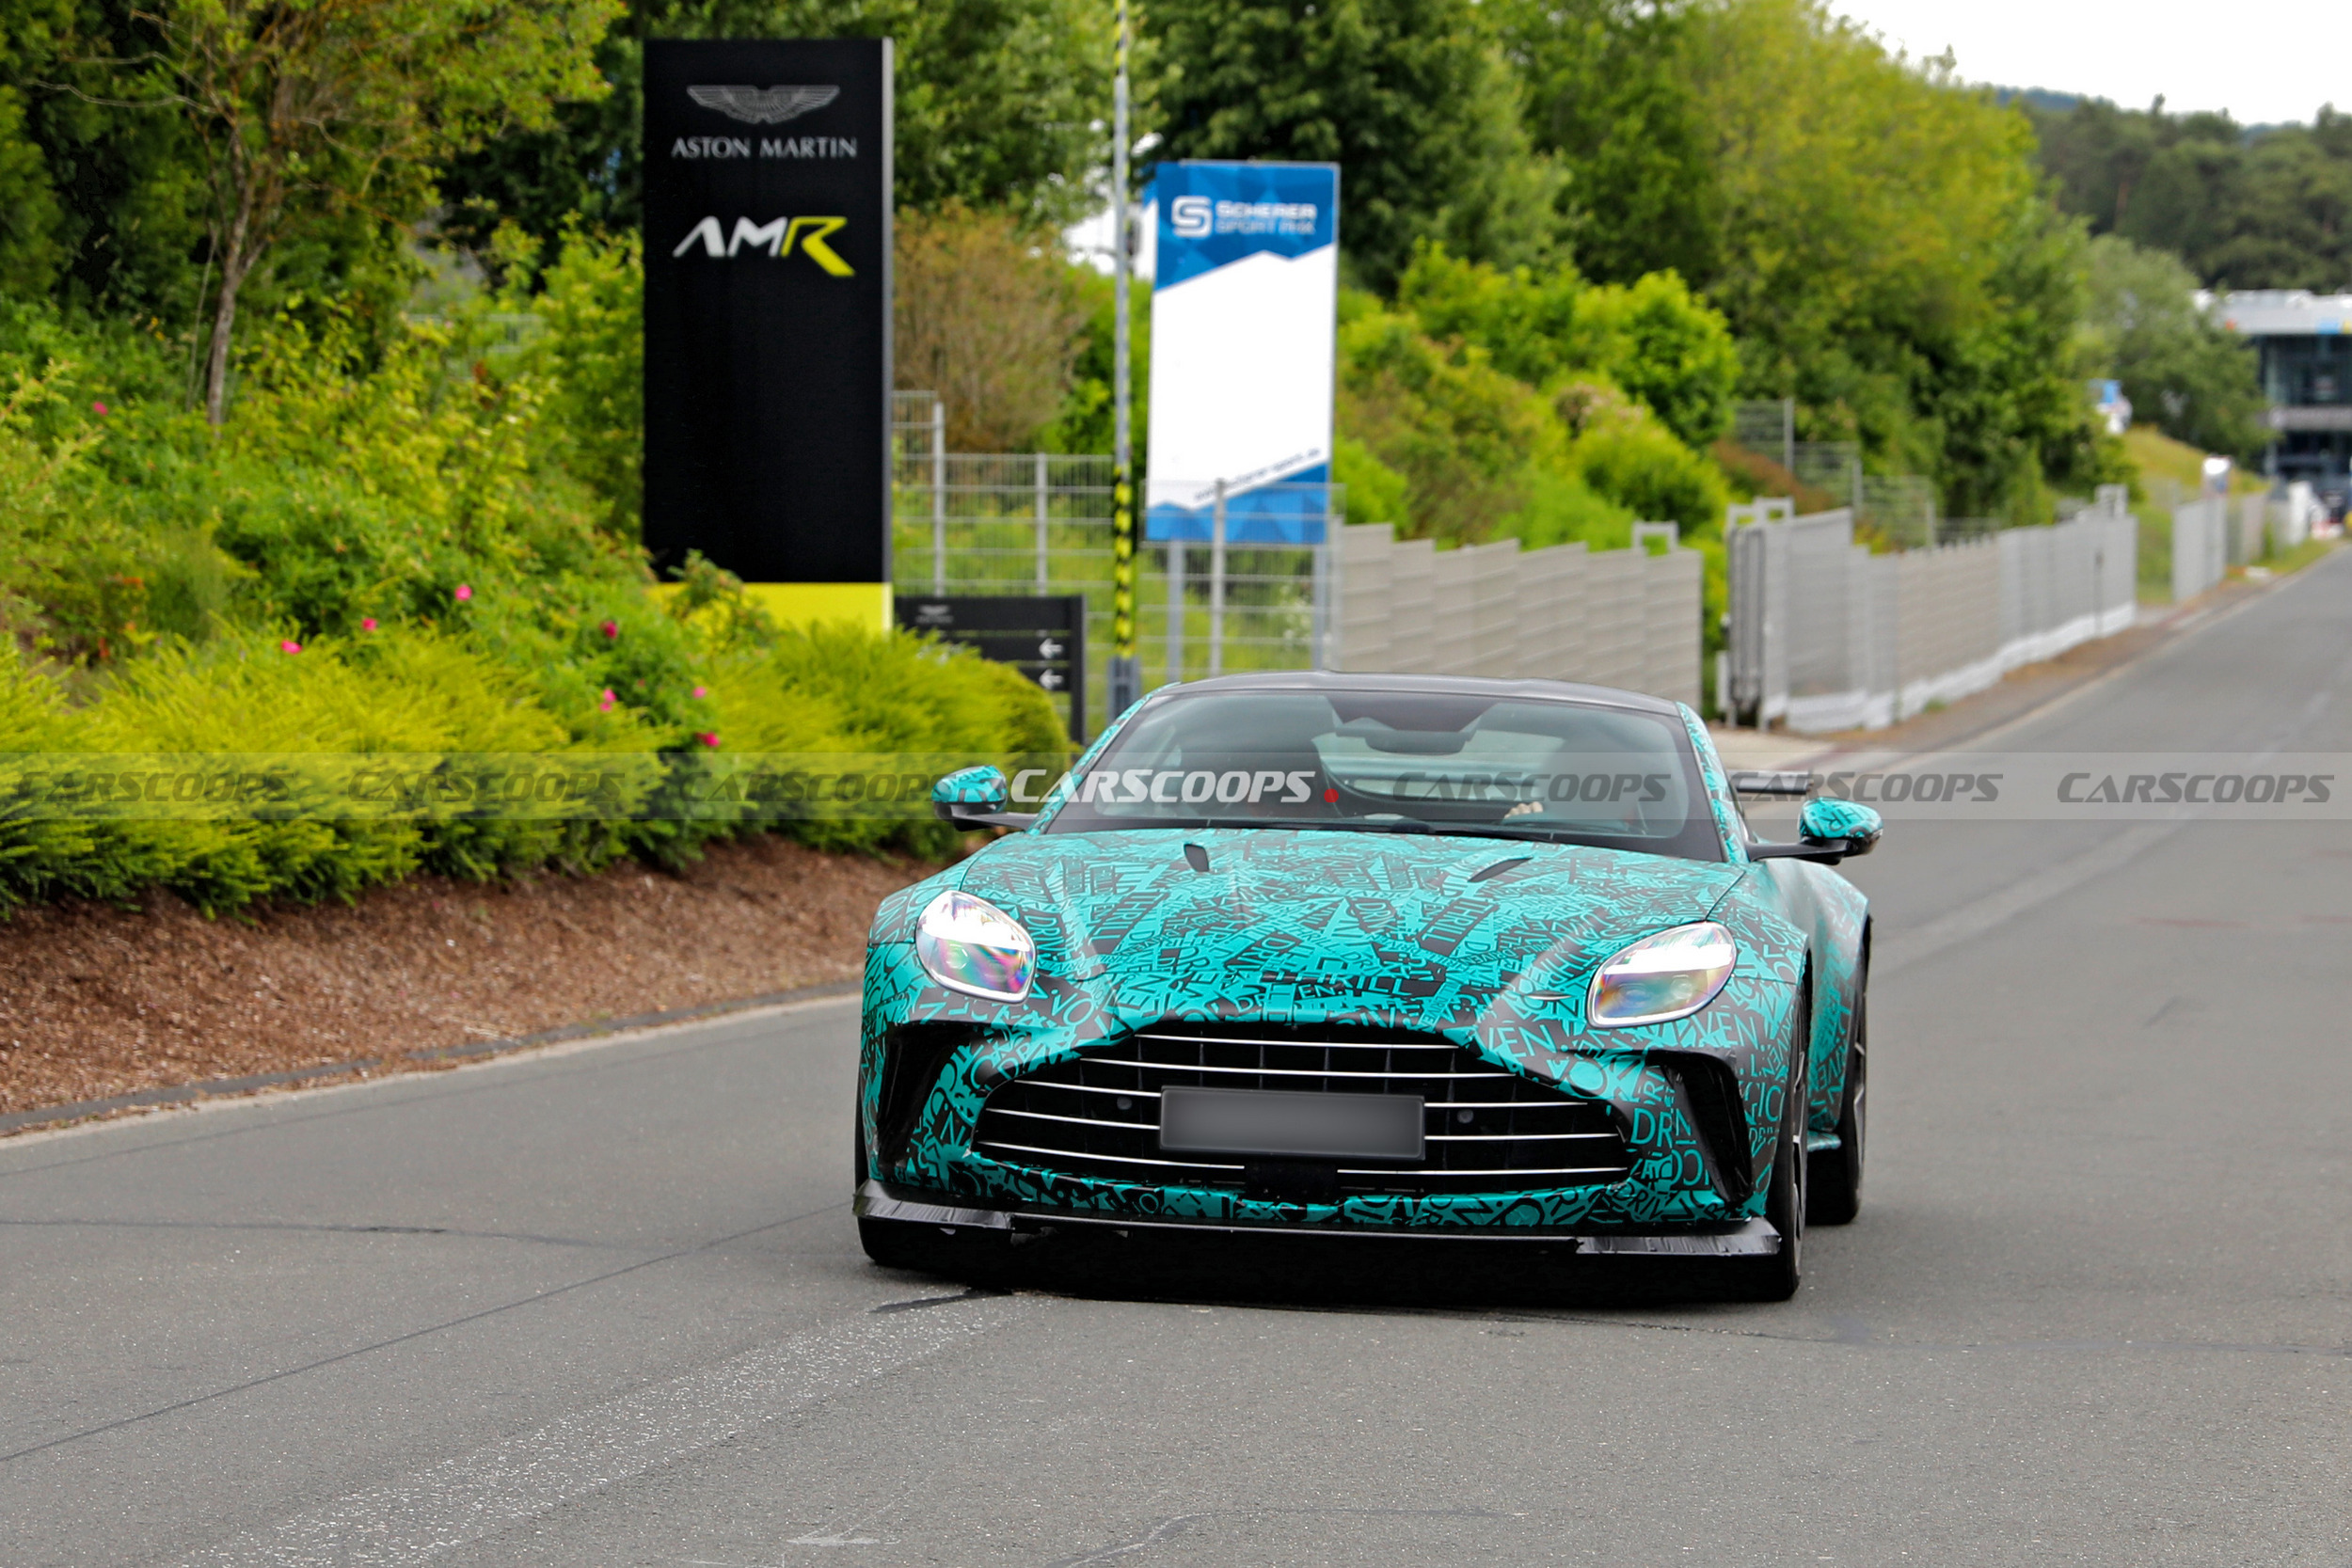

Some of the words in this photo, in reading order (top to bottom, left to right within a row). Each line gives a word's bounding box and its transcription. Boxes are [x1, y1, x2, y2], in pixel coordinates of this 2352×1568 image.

[671, 136, 751, 158] ASTON
[759, 136, 857, 158] MARTIN
[672, 216, 855, 276] AMR
